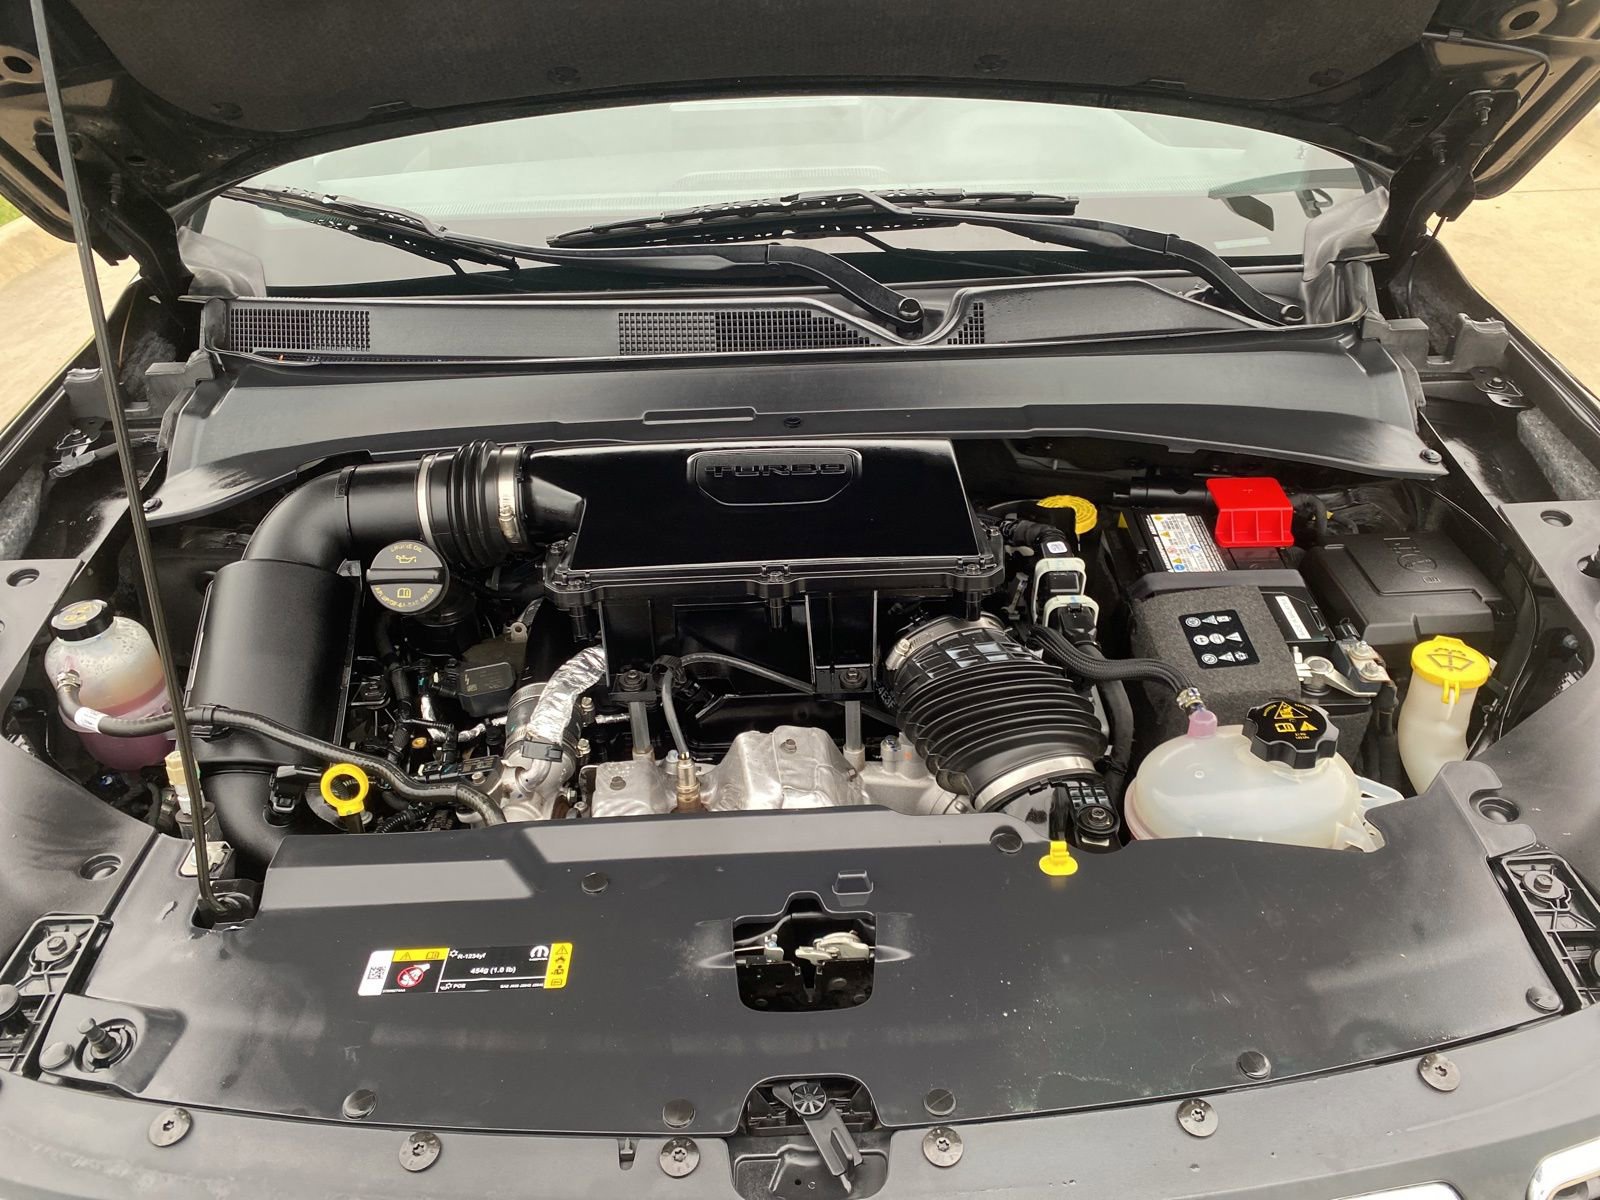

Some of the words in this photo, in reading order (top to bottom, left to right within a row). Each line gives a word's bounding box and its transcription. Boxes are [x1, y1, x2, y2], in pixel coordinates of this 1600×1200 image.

[705, 463, 847, 478] TURBO
[457, 951, 486, 960] R-1234yf
[470, 966, 489, 974] 454g
